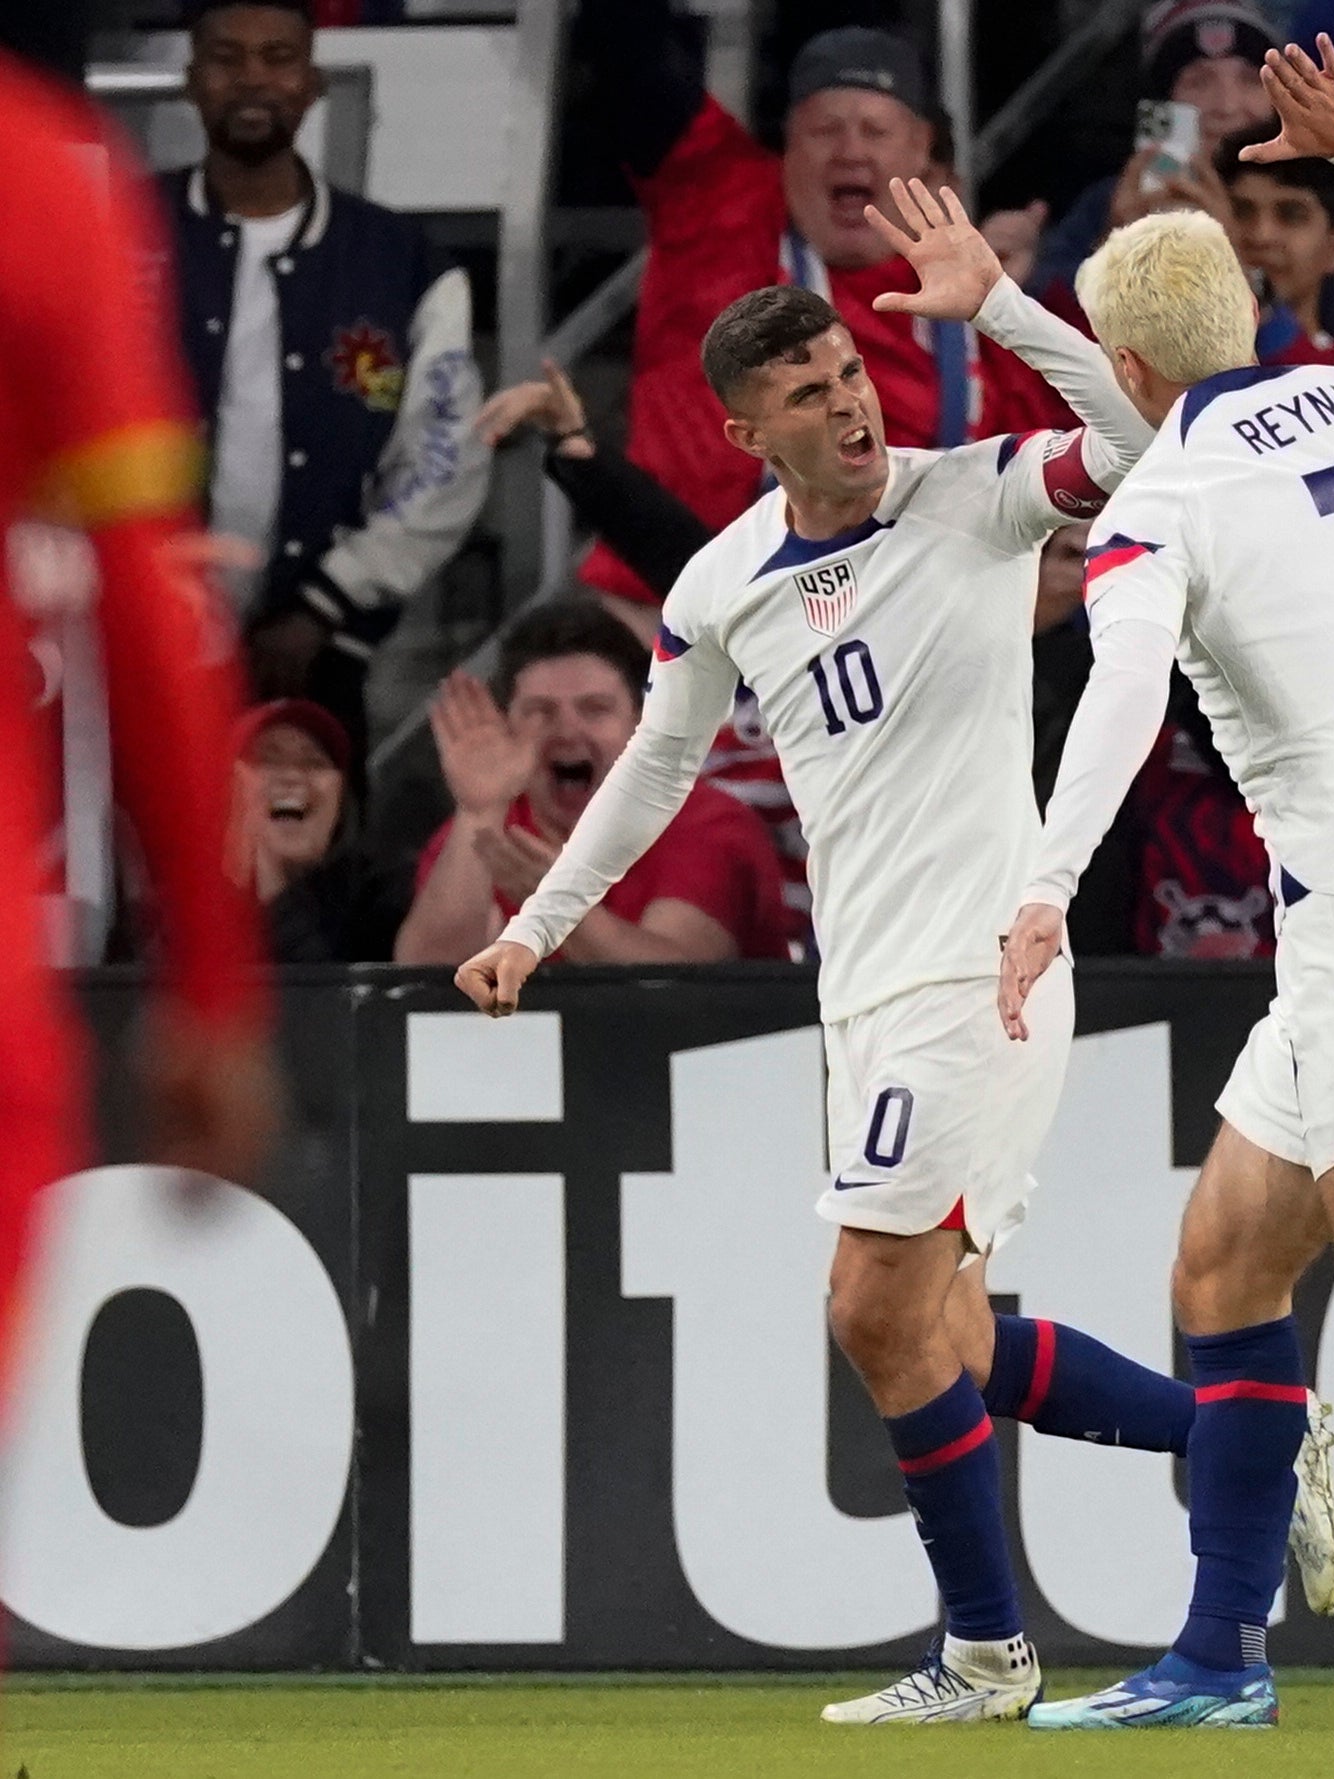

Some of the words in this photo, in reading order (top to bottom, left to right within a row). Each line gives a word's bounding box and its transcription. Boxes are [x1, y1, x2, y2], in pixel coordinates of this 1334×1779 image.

[800, 564, 851, 596] USA
[807, 639, 884, 736] 10
[863, 1086, 914, 1168] 0
